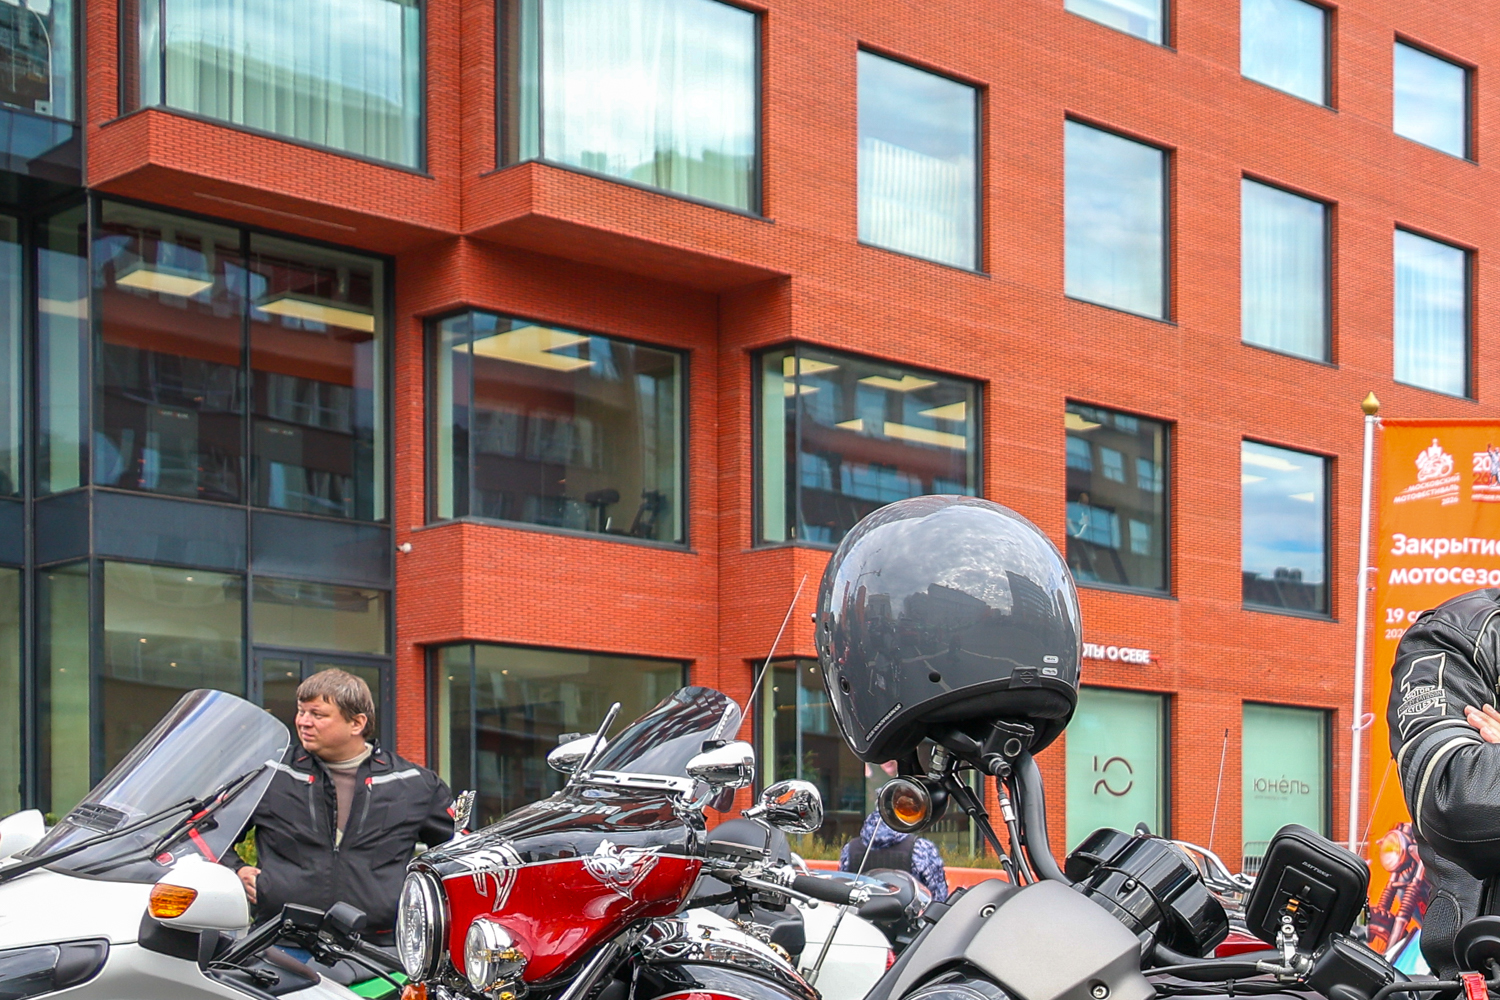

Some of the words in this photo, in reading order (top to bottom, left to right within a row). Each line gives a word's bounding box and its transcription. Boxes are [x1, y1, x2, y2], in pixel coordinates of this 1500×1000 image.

[1385, 608, 1405, 623] 19
[1106, 646, 1118, 660] О
[1120, 647, 1151, 664] СЕБЕ
